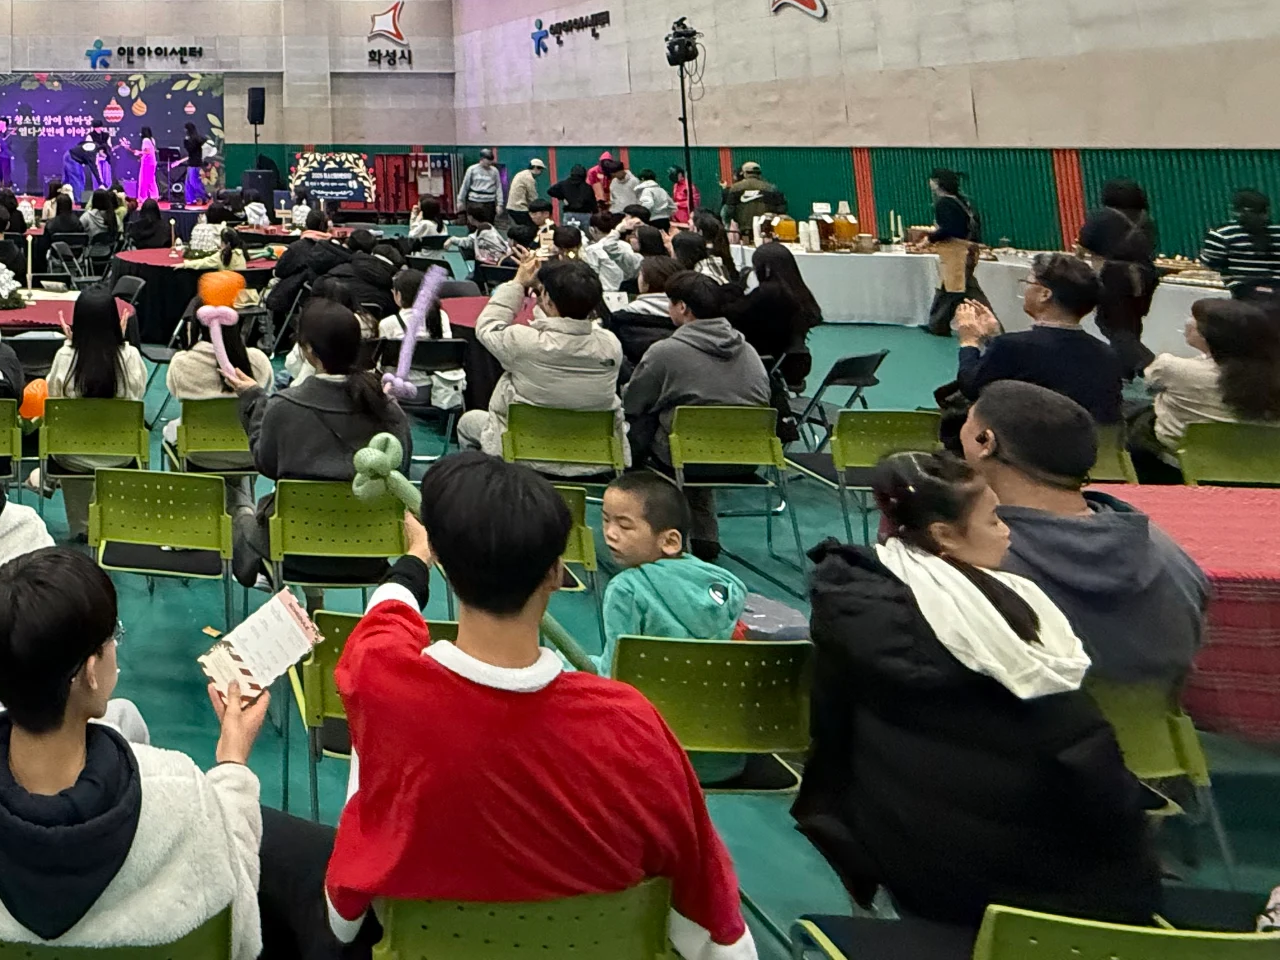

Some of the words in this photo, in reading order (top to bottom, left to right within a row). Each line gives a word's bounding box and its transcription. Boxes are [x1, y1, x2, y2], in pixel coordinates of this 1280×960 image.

[117, 46, 203, 65] 앤아이센터
[368, 49, 412, 66] 화성시
[14, 115, 40, 126] 청소년
